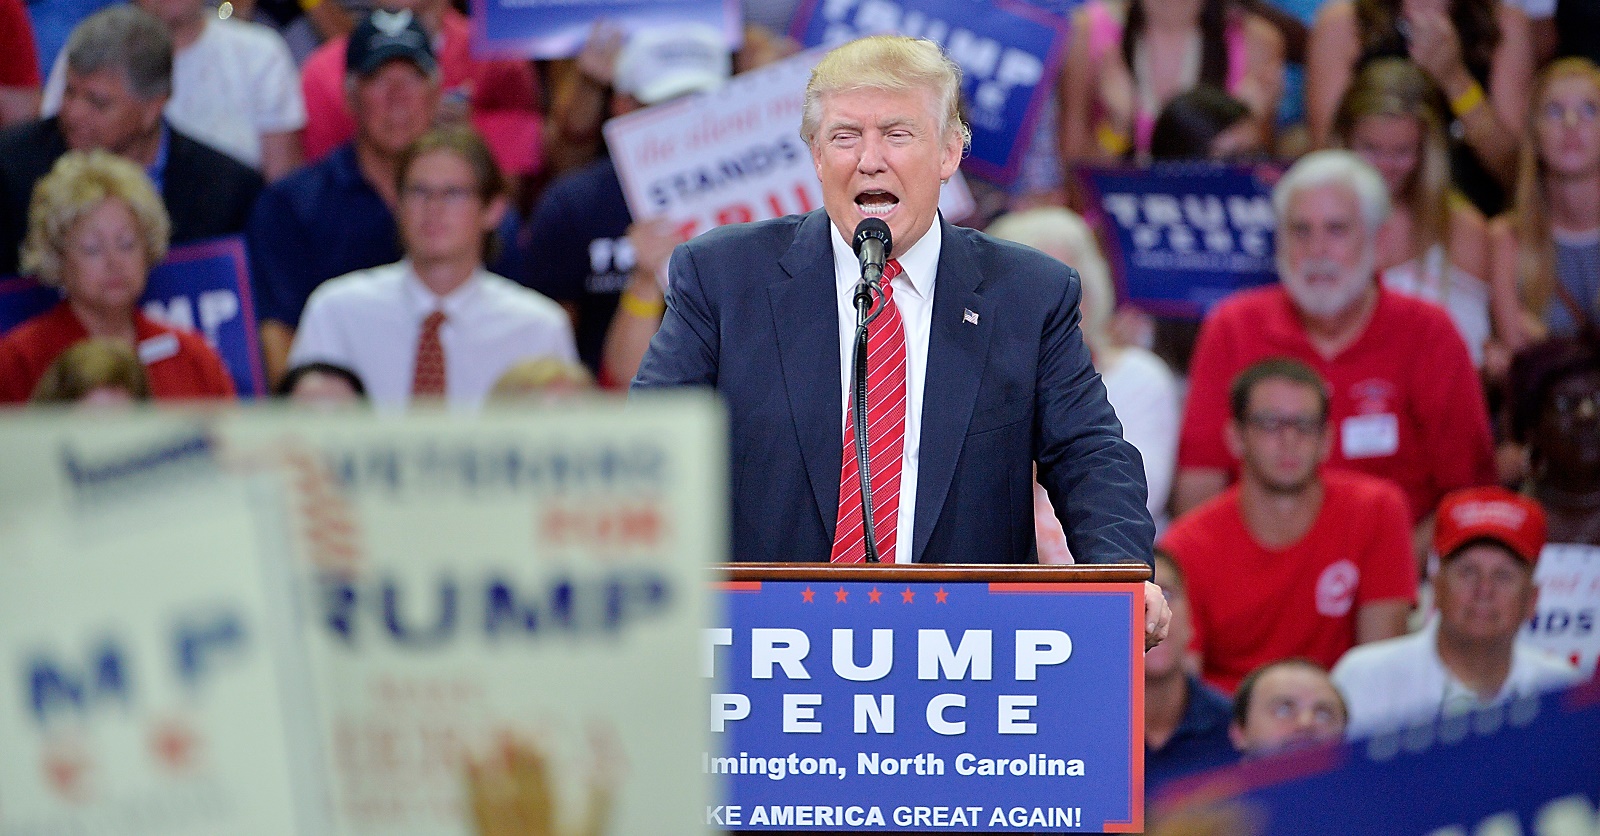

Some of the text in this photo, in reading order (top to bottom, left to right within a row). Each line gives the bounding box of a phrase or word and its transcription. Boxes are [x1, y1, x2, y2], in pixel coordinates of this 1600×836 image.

[648, 133, 800, 208] STANDS
[699, 627, 1073, 682] TRUMP
[710, 693, 1038, 736] PENCE
[857, 752, 945, 776] North
[955, 752, 1085, 776] Carolina
[702, 805, 1082, 828] KE AMERICA GREAT AGAIN!
